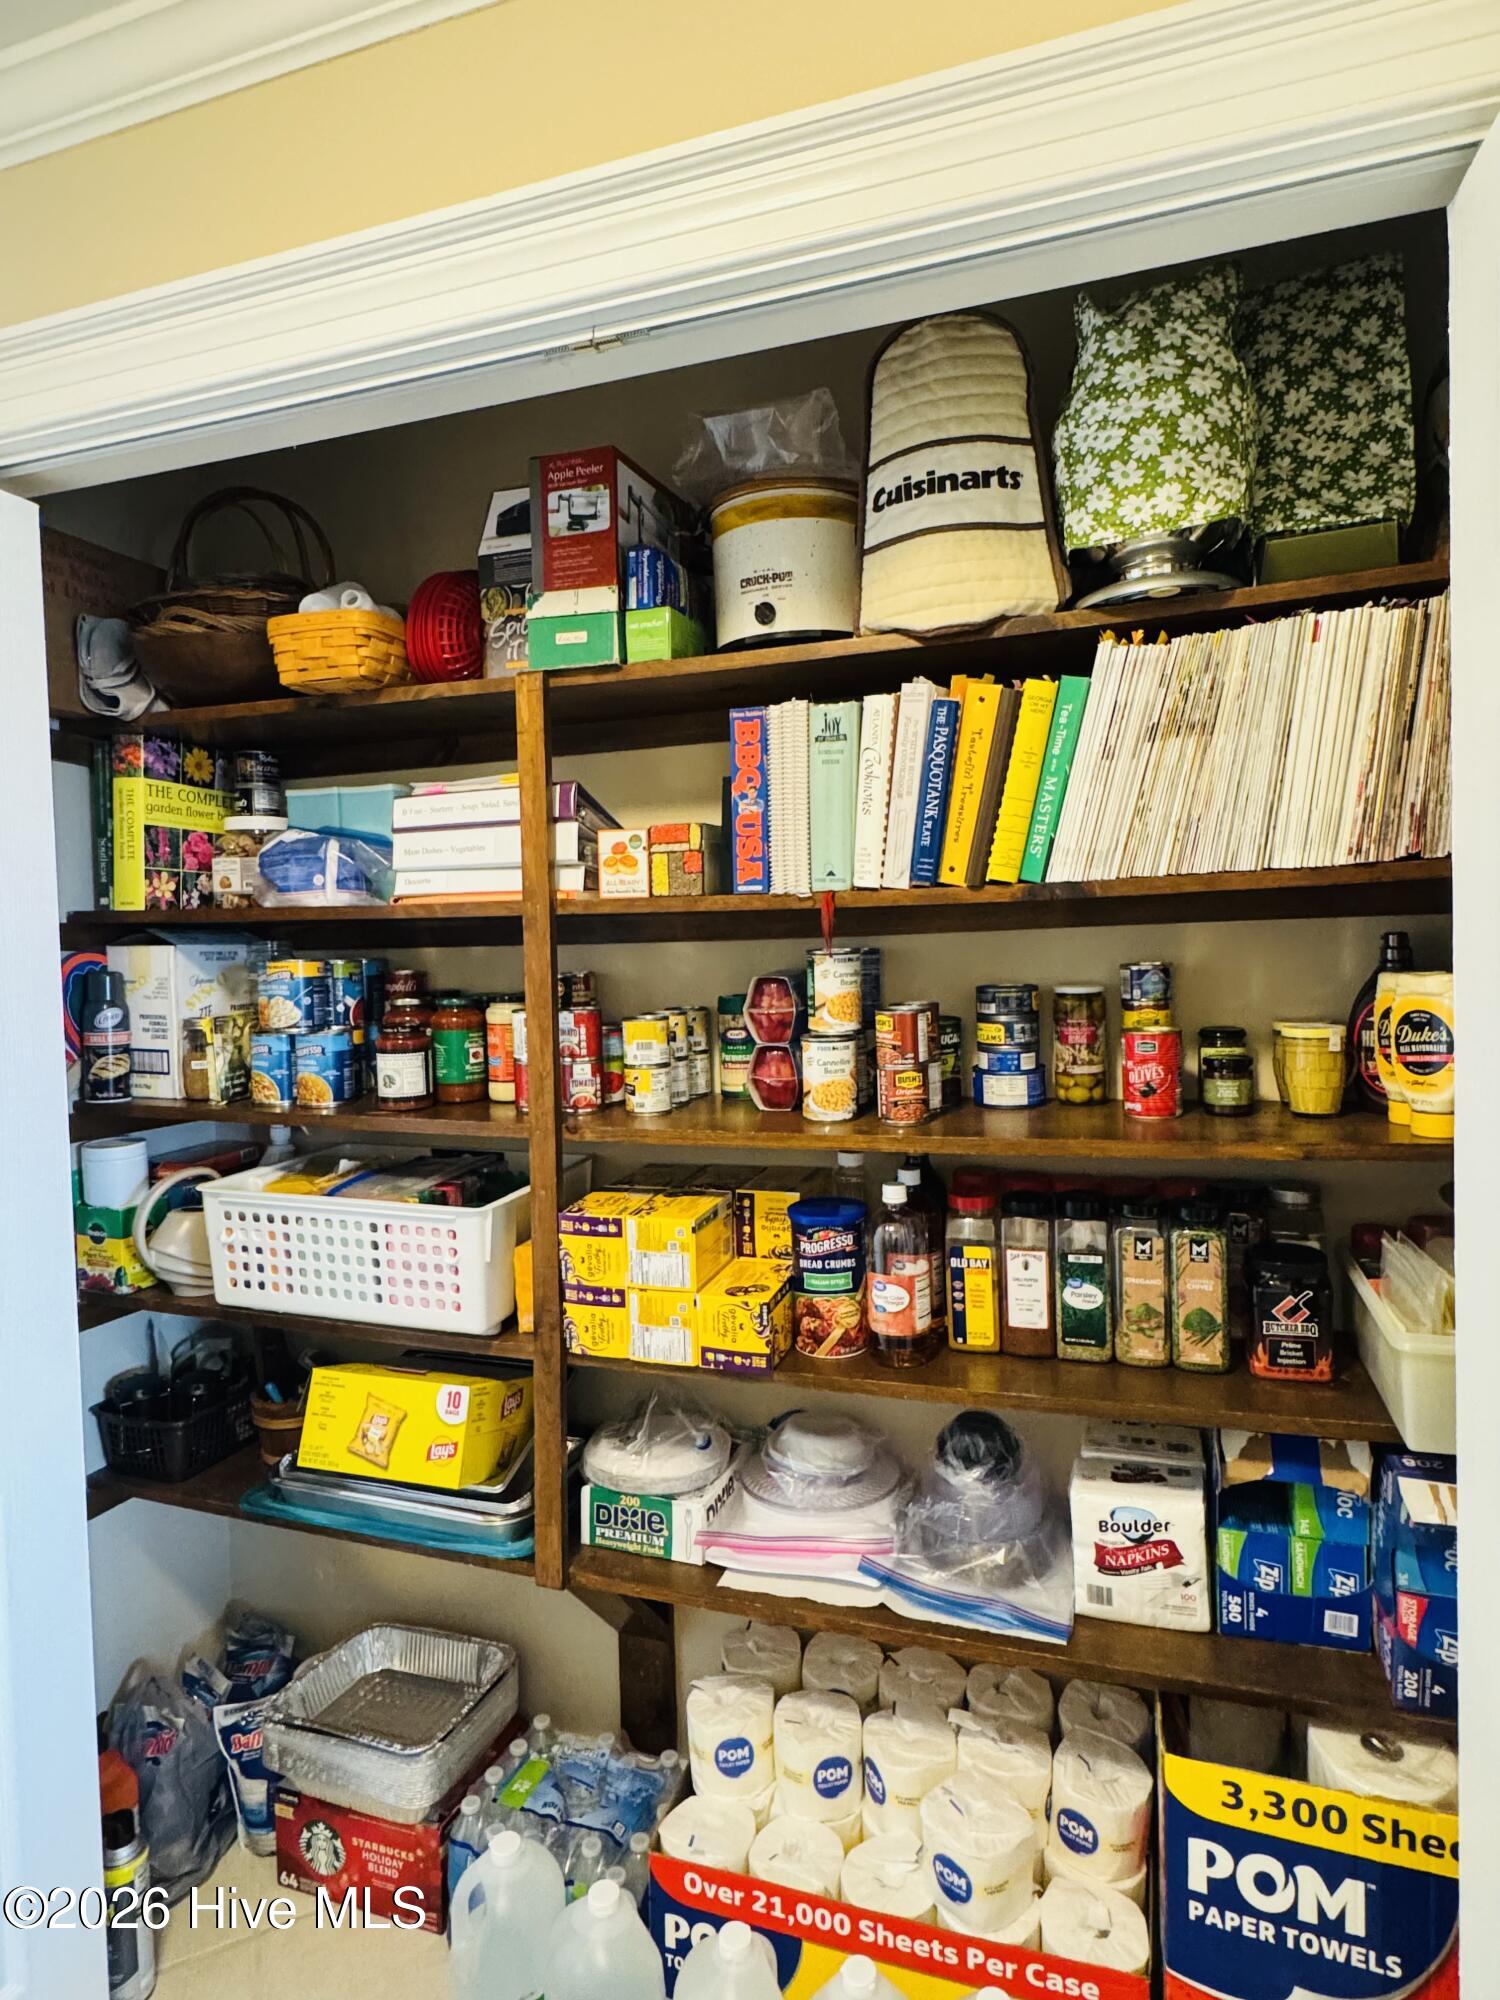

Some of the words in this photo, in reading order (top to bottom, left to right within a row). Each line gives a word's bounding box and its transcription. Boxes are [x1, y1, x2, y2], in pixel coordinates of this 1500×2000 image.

[548, 467, 574, 482] Apple
[576, 463, 604, 476] Peeler
[872, 466, 1021, 513] Cuisinarts
[821, 712, 842, 734] JOY
[936, 706, 947, 725] THE
[1052, 703, 1073, 755] Tea-Time
[732, 720, 761, 796] BBQ
[861, 747, 881, 816] Cooknotes
[924, 726, 948, 819] PASQUOTANK
[126, 789, 135, 805] THE
[146, 783, 173, 800] THE
[178, 788, 236, 811] COMPLE
[145, 803, 182, 816] garden
[185, 806, 215, 820] flower
[126, 810, 135, 861] COMPLETE
[920, 820, 932, 848] PLATE
[450, 844, 486, 854] Vegetables
[736, 811, 762, 885] USA
[1397, 1023, 1447, 1043] Duke's
[571, 1078, 595, 1088] TOMATO
[898, 1076, 922, 1084] BUSH'S
[1129, 1066, 1164, 1083] OLIVES
[800, 1234, 854, 1254] PROGRESSO
[799, 1258, 822, 1269] BREAD
[824, 1258, 856, 1269] CRUMBS
[950, 1257, 968, 1268] OLD
[969, 1258, 988, 1268] BAY
[1125, 1277, 1162, 1285] OREGANO
[1071, 1291, 1097, 1299] Parsley
[1264, 1322, 1299, 1333] BUTCHER
[1300, 1324, 1317, 1336] BBQ
[1277, 1357, 1307, 1365] Injection
[1279, 1349, 1304, 1357] Brisket
[447, 1391, 462, 1409] 10
[503, 1390, 522, 1416] Lay's
[429, 1443, 455, 1459] Lay's
[619, 1495, 640, 1506] 200
[1099, 1519, 1170, 1533] Boulder
[595, 1527, 664, 1547] PREMIUM
[1104, 1543, 1170, 1567] NAPKINS
[1295, 1541, 1304, 1589] SANDWICH
[1253, 1564, 1279, 1591] Zip
[1328, 1573, 1356, 1597] Zip
[1181, 1593, 1197, 1602] 100
[1228, 1594, 1241, 1622] 580
[1255, 1608, 1268, 1618] 4
[1407, 1599, 1417, 1641] STORAGE
[1434, 1633, 1457, 1664] Zip
[1403, 1669, 1418, 1699] 208
[1432, 1685, 1445, 1696] 4
[718, 1745, 749, 1761] POM
[817, 1765, 848, 1783] POM
[1059, 1813, 1094, 1843] POM
[1221, 1780, 1347, 1835] 3,300
[1362, 1814, 1458, 1862] She
[351, 1837, 415, 1862] STARBUCKS
[362, 1850, 404, 1869] HOLIDAY
[280, 1871, 299, 1888] 64
[367, 1863, 399, 1879] BLEND
[935, 1860, 967, 1891] POM
[1187, 1836, 1366, 1938] POM
[664, 1912, 718, 1949] PO
[684, 1871, 744, 1907] Over
[752, 1890, 851, 1936] 21,000
[859, 1918, 959, 1966] Sheets
[966, 1947, 1018, 1979] Per
[1026, 1962, 1100, 2000] Case
[1188, 1899, 1276, 1944] PAPER
[1281, 1926, 1403, 1979] TOWELS
